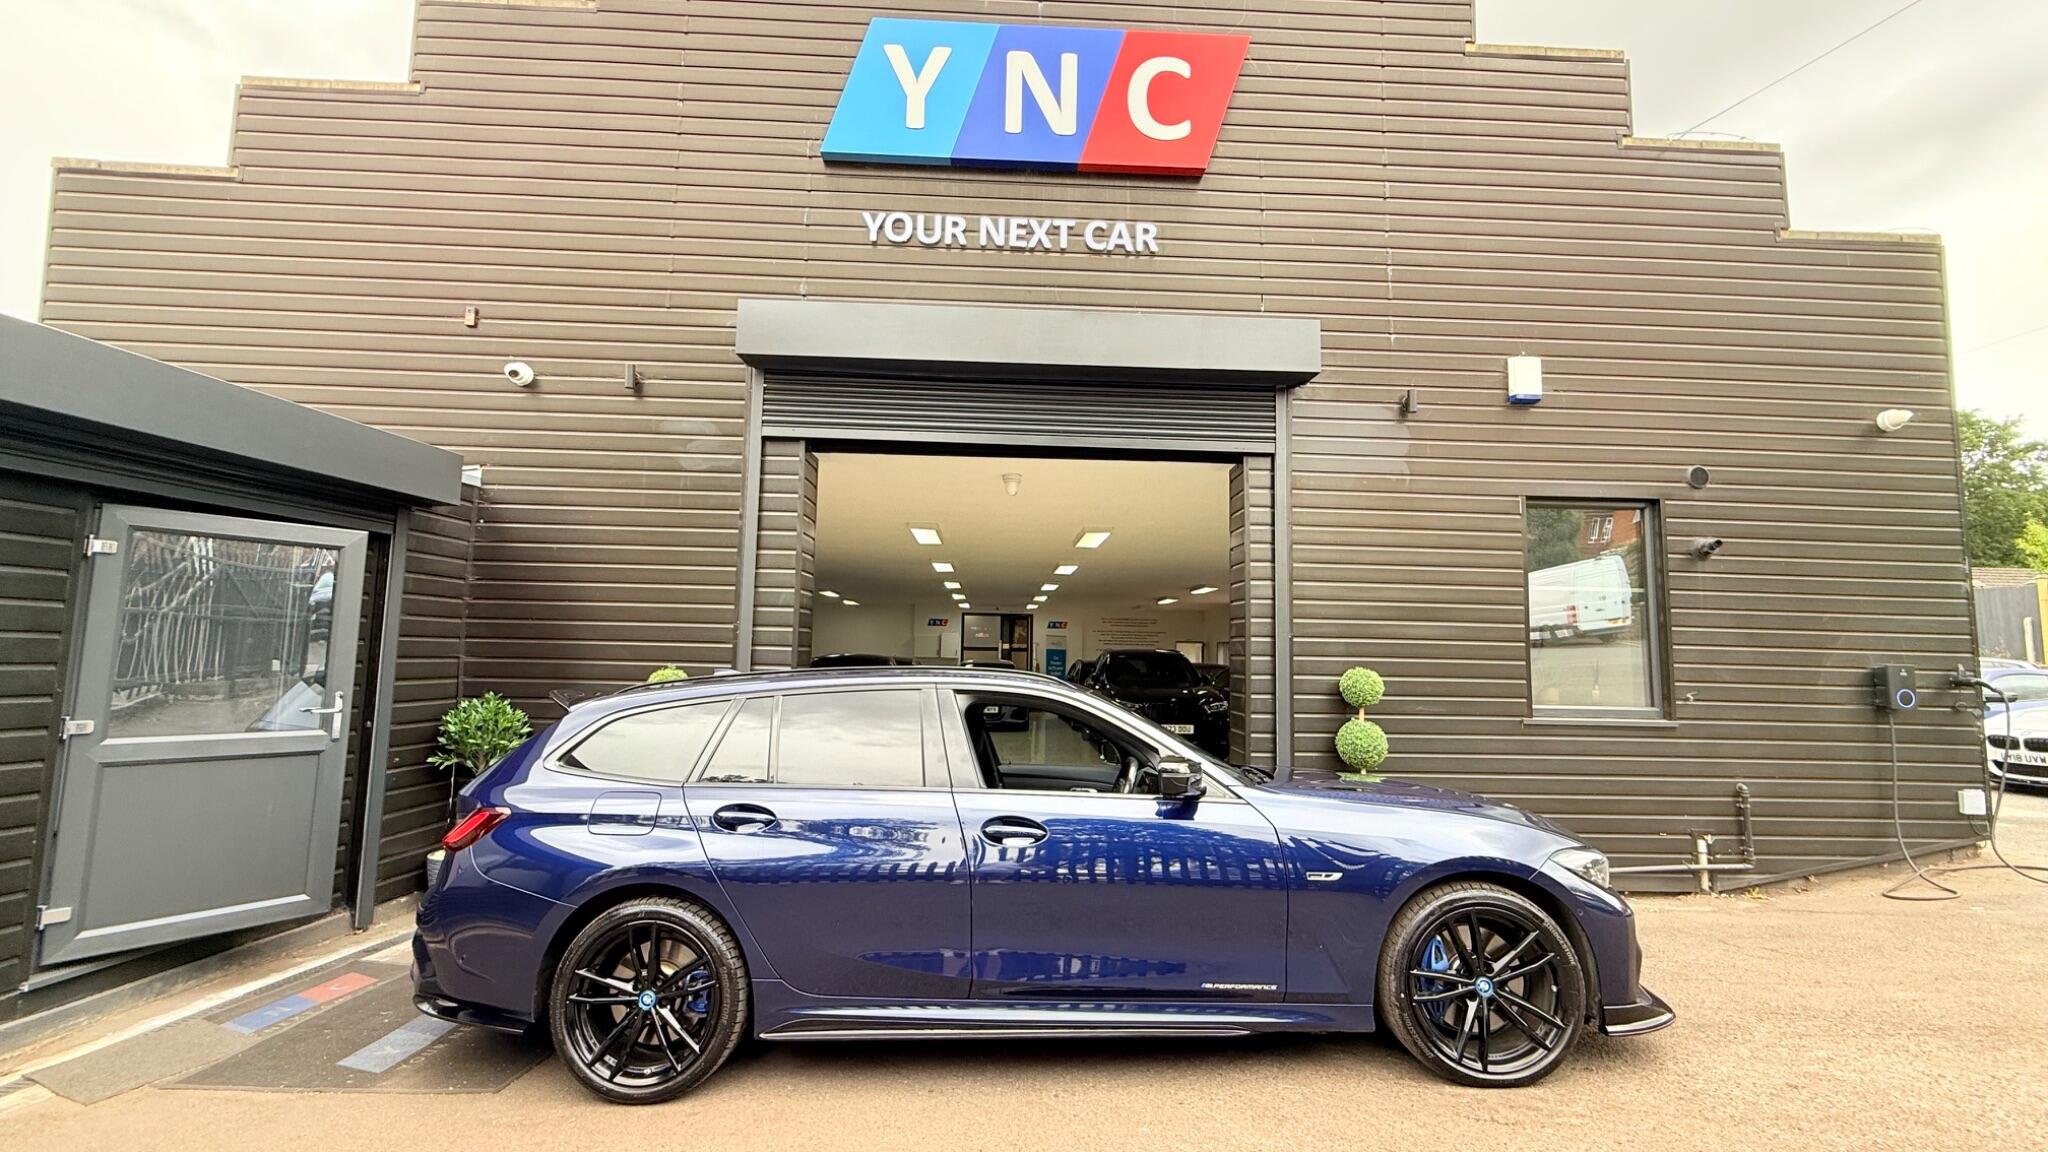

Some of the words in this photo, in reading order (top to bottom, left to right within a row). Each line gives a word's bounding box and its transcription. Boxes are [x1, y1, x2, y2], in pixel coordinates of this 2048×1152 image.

[862, 211, 967, 247] YOUR
[979, 216, 1075, 251] NEXT
[1084, 219, 1160, 253] CAR
